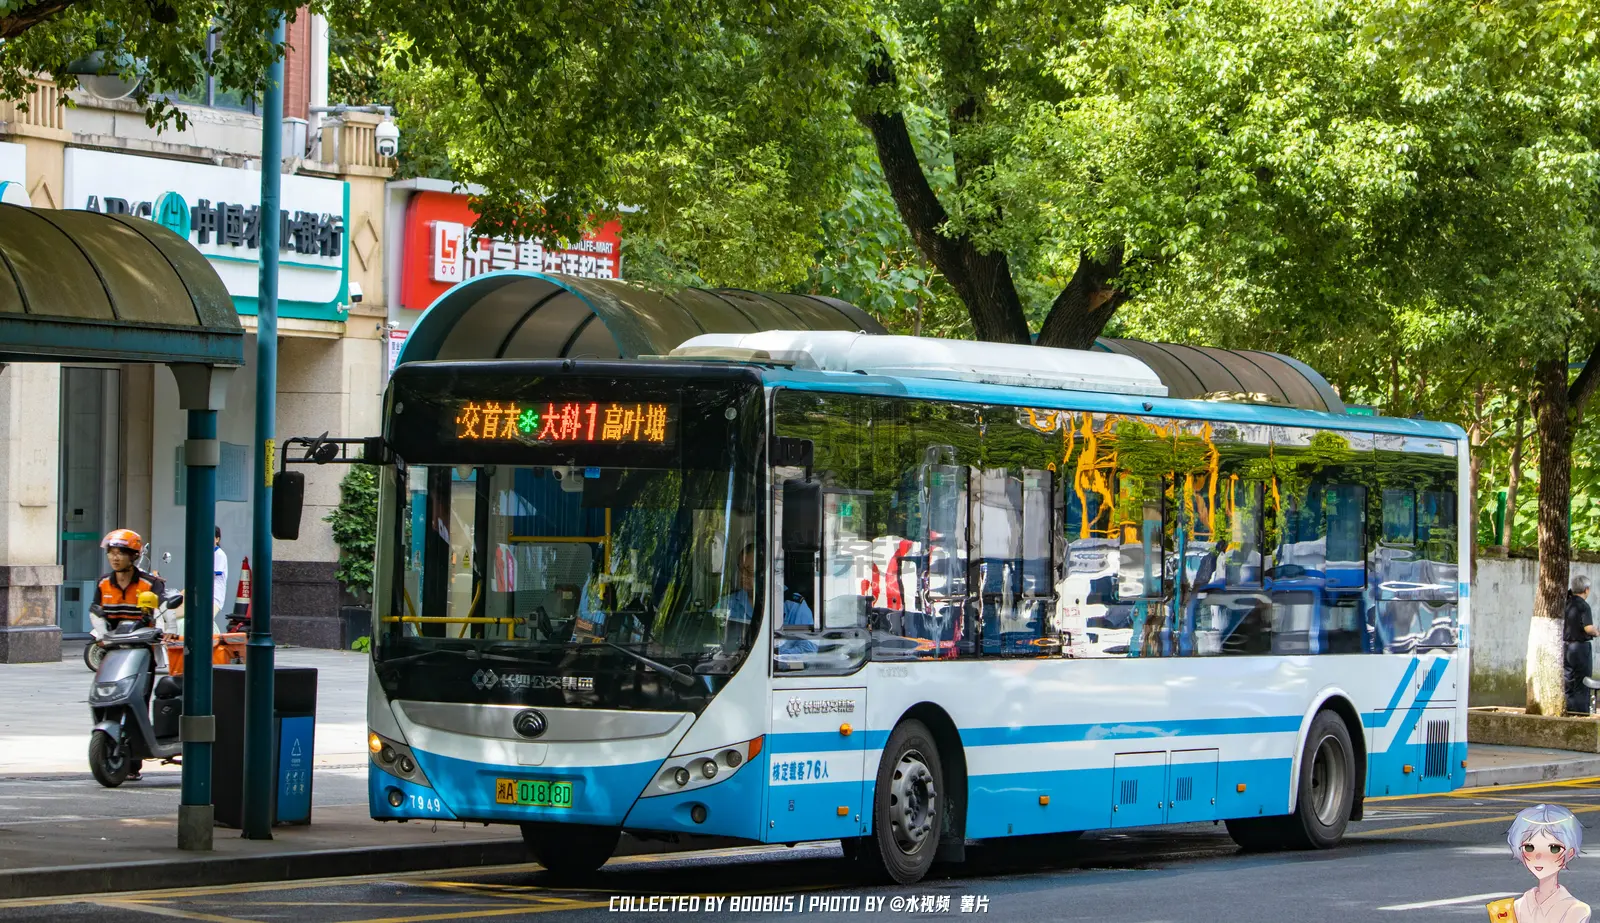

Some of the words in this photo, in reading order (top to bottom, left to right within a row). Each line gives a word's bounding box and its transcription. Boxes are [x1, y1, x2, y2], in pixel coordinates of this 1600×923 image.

[601, 403, 667, 441] 高叶塘
[410, 794, 441, 813] 7949
